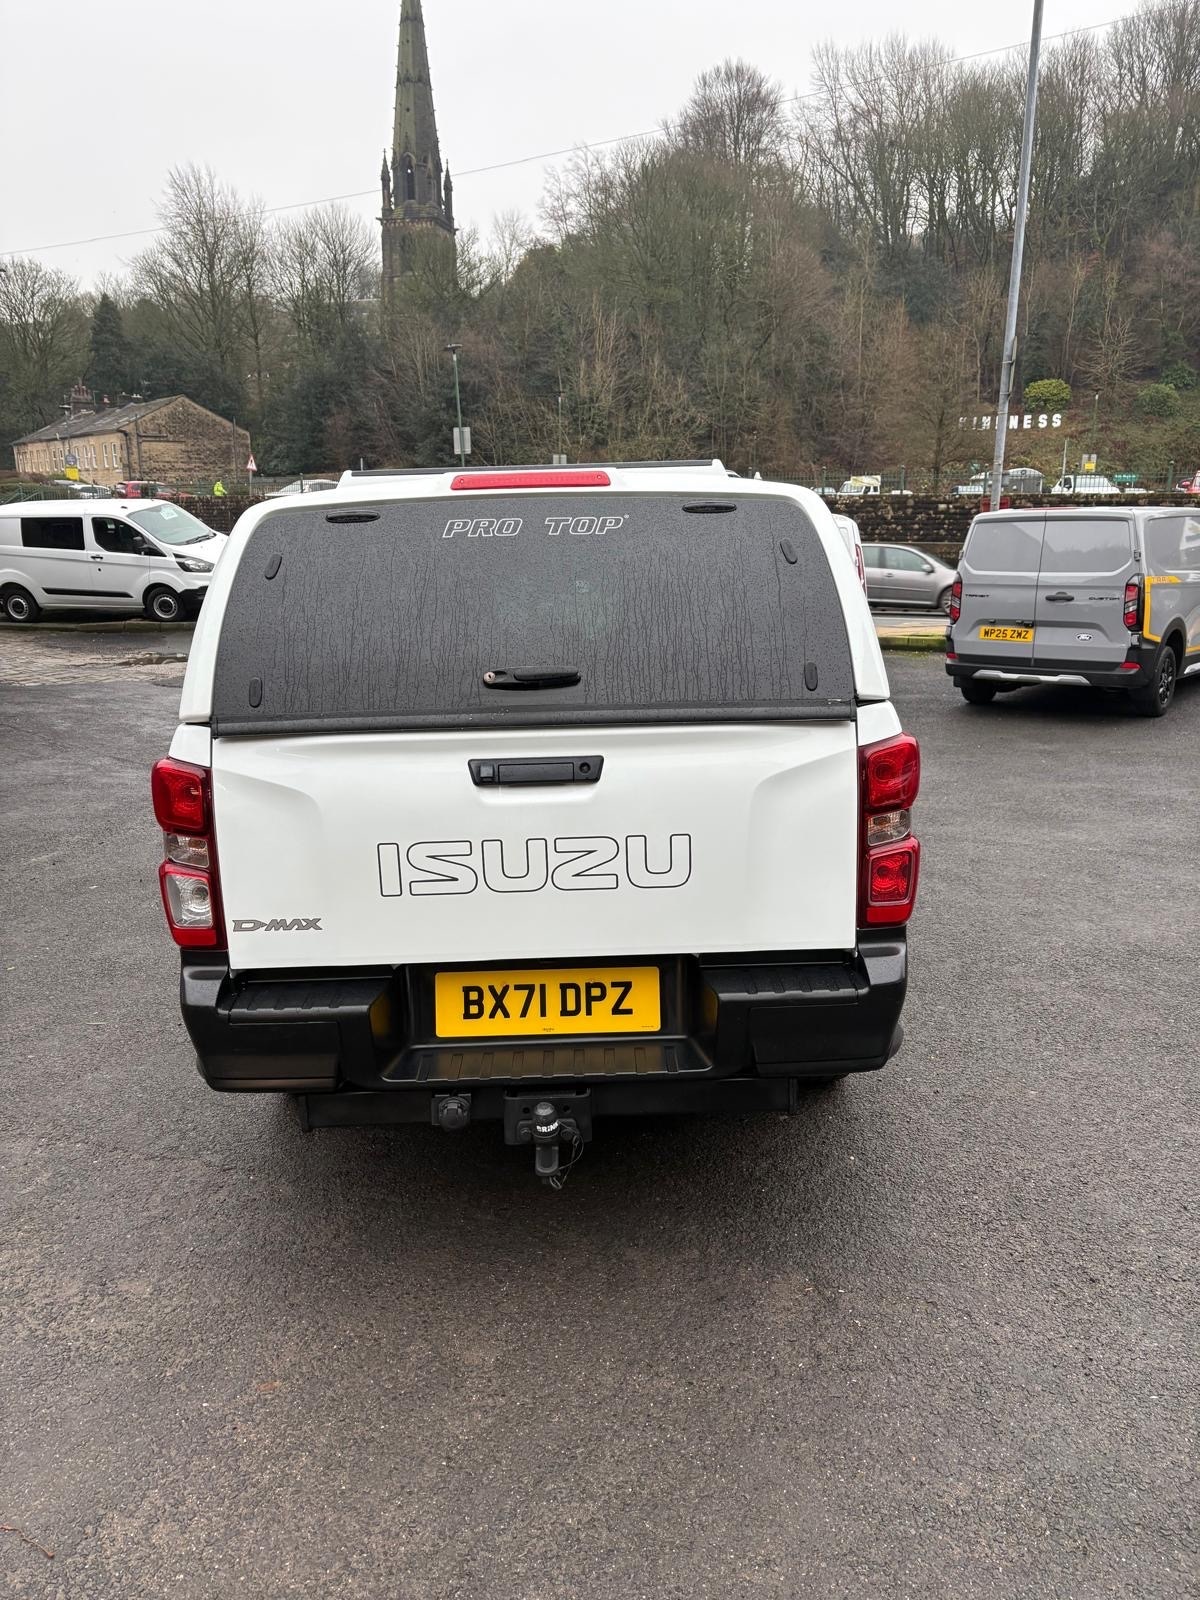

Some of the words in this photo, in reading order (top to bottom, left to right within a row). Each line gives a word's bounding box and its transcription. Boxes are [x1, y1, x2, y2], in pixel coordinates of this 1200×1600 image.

[442, 518, 523, 538] PRO
[983, 628, 1008, 639] WP25
[1010, 629, 1030, 640] ZWZ
[377, 833, 692, 897] ISUZU
[232, 918, 323, 932] D-MAX
[462, 982, 548, 1020] BX71
[559, 980, 634, 1018] DPZ
